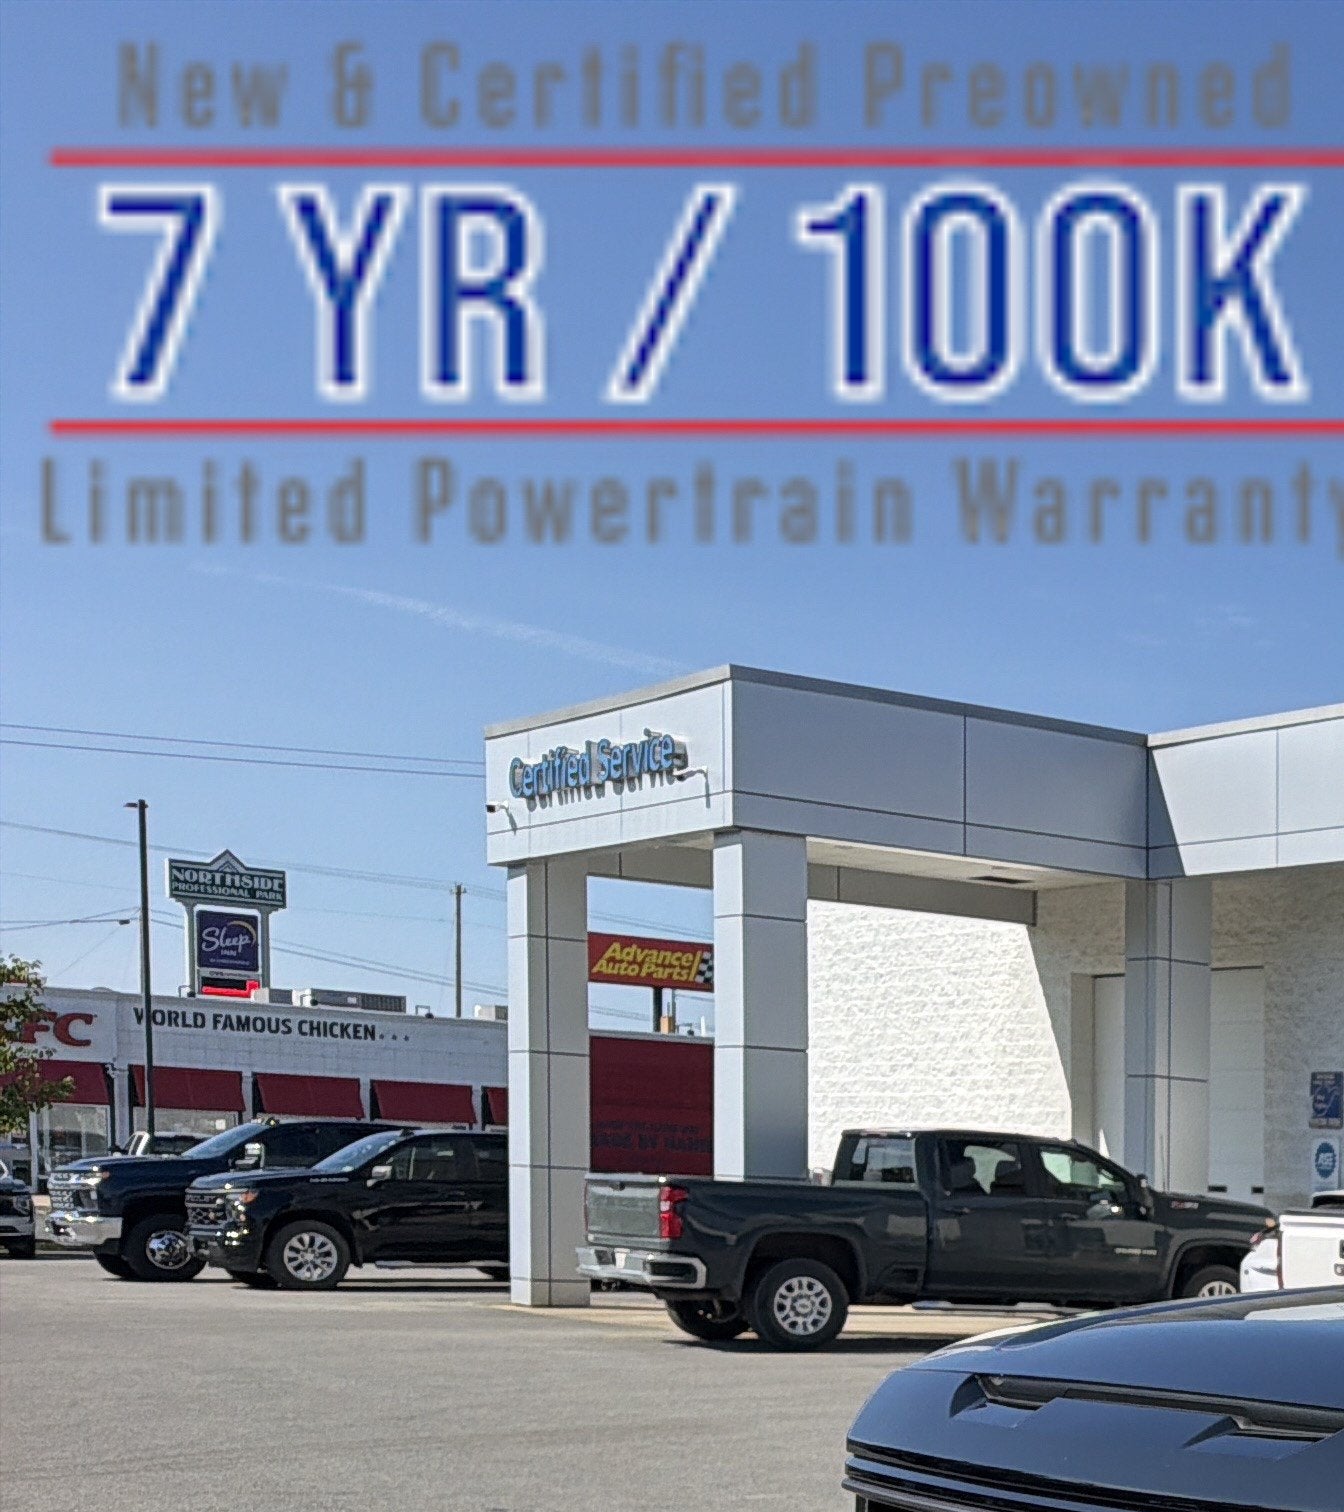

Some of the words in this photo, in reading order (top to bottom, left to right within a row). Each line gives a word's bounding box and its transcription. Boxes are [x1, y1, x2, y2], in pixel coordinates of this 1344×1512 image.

[509, 740, 592, 798] Certified
[597, 730, 677, 782] Service
[171, 868, 284, 891] NORTHSIDE
[171, 881, 251, 898] PROFESSIONAL
[255, 891, 283, 901] PARK
[201, 926, 251, 953] Sleep
[602, 942, 694, 966] Advance
[591, 959, 640, 976] Auto
[640, 962, 690, 981] Parts
[18, 1010, 94, 1047] FC
[212, 1014, 293, 1035] FAMOUS
